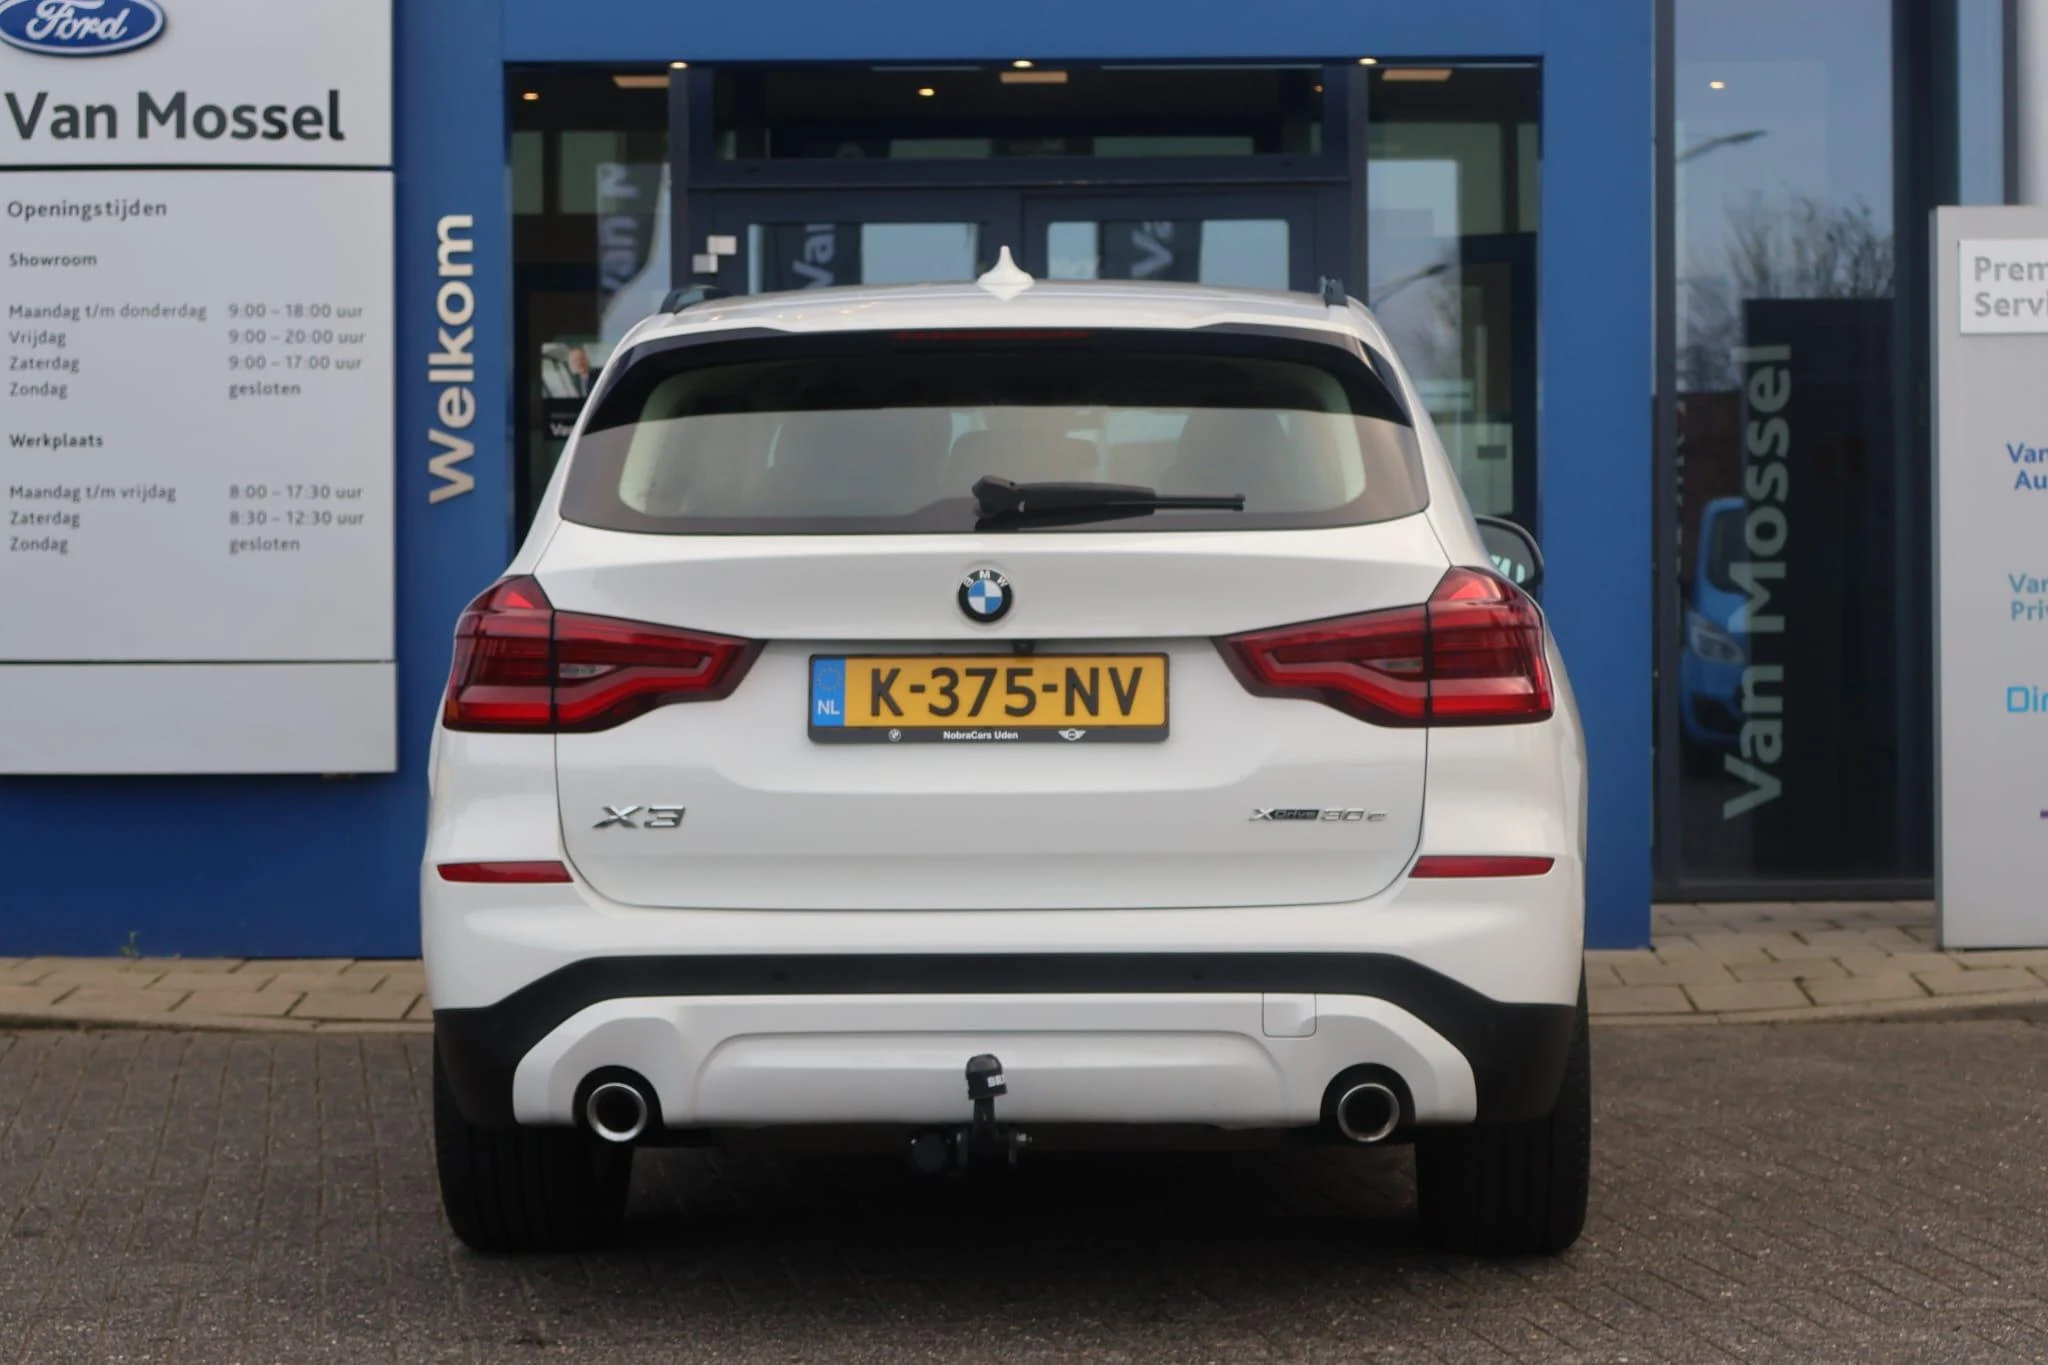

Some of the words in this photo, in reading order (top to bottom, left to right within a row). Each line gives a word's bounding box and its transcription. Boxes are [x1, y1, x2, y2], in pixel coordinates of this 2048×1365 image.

[26, 0, 131, 41] Ford
[5, 91, 117, 140] Van
[137, 89, 346, 141] Mossel
[7, 199, 168, 222] Openingstijden
[9, 253, 98, 267] Showroom
[9, 304, 81, 322] Maandag
[85, 304, 115, 318] t/m
[120, 303, 208, 322] donderdag
[336, 306, 363, 318] uur
[9, 330, 67, 348] Vrijdag
[338, 332, 366, 344] uur
[9, 356, 80, 374] Zaterdag
[334, 358, 362, 370] uur
[428, 214, 477, 505] Welkom
[9, 382, 68, 400] Zondag
[229, 380, 302, 400] gesloten
[9, 433, 104, 451] Werkplaats
[9, 485, 81, 503] Maandag
[86, 485, 116, 499] t/m
[120, 485, 177, 503] vrijdag
[335, 487, 363, 499] uur
[1727, 345, 1791, 634] Mossel
[10, 511, 80, 529] Zaterdag
[337, 513, 365, 525] uur
[10, 537, 68, 555] Zondag
[229, 535, 301, 555] gesloten
[958, 569, 1010, 589] BMW
[869, 666, 1143, 718] K-375-NV
[817, 700, 840, 715] NL
[943, 730, 993, 740] NobraCars
[993, 730, 1019, 740] Uden
[1723, 664, 1785, 820] Van
[592, 804, 686, 828] X3
